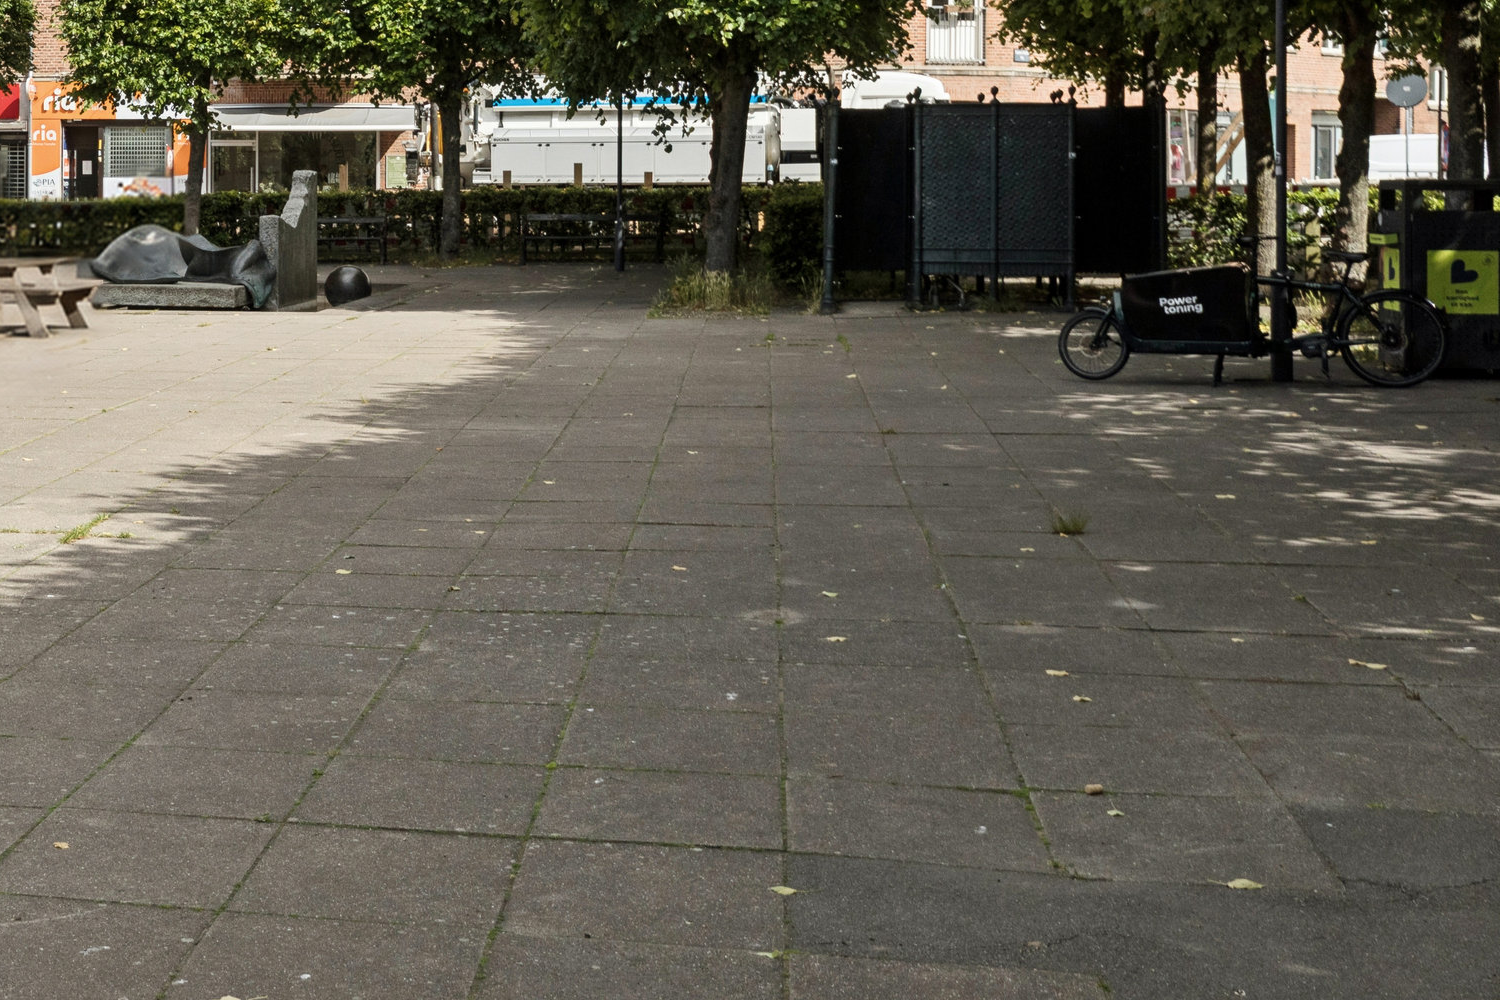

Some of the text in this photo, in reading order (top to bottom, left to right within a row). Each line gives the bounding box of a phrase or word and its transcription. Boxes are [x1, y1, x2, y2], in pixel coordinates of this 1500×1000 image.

[43, 88, 76, 111] ria
[32, 124, 57, 141] ria
[1159, 296, 1198, 307] Power
[1164, 303, 1203, 315] toning
